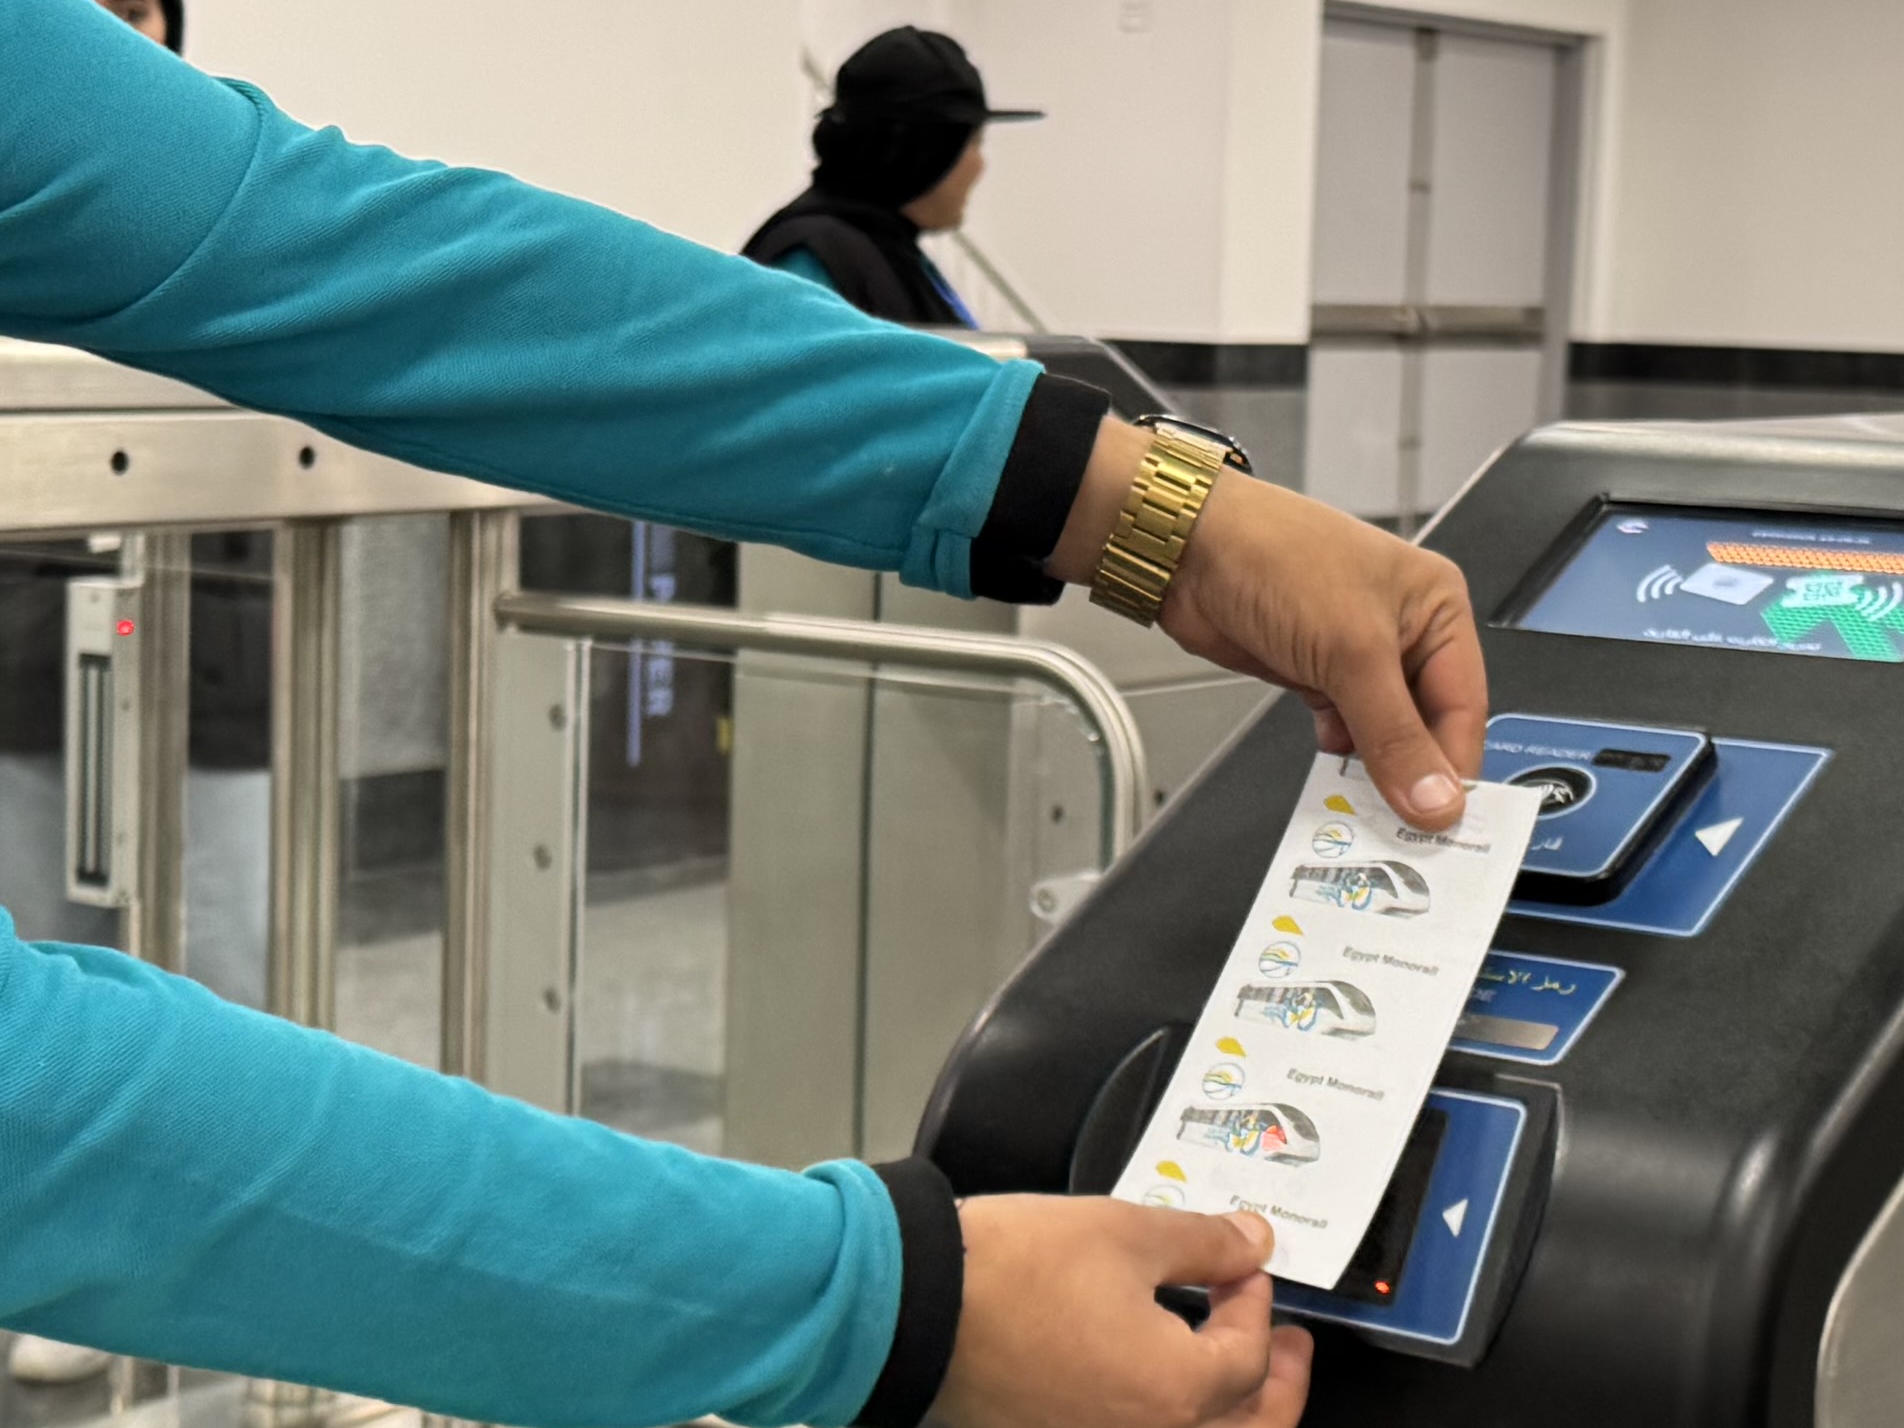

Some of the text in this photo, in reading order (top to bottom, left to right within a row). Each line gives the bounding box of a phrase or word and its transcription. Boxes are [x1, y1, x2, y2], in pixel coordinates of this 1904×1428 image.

[1342, 945, 1440, 976] Egypt Monorail
[1286, 1067, 1385, 1102] Egypt Monorail
[1270, 1204, 1329, 1230] Monorail
